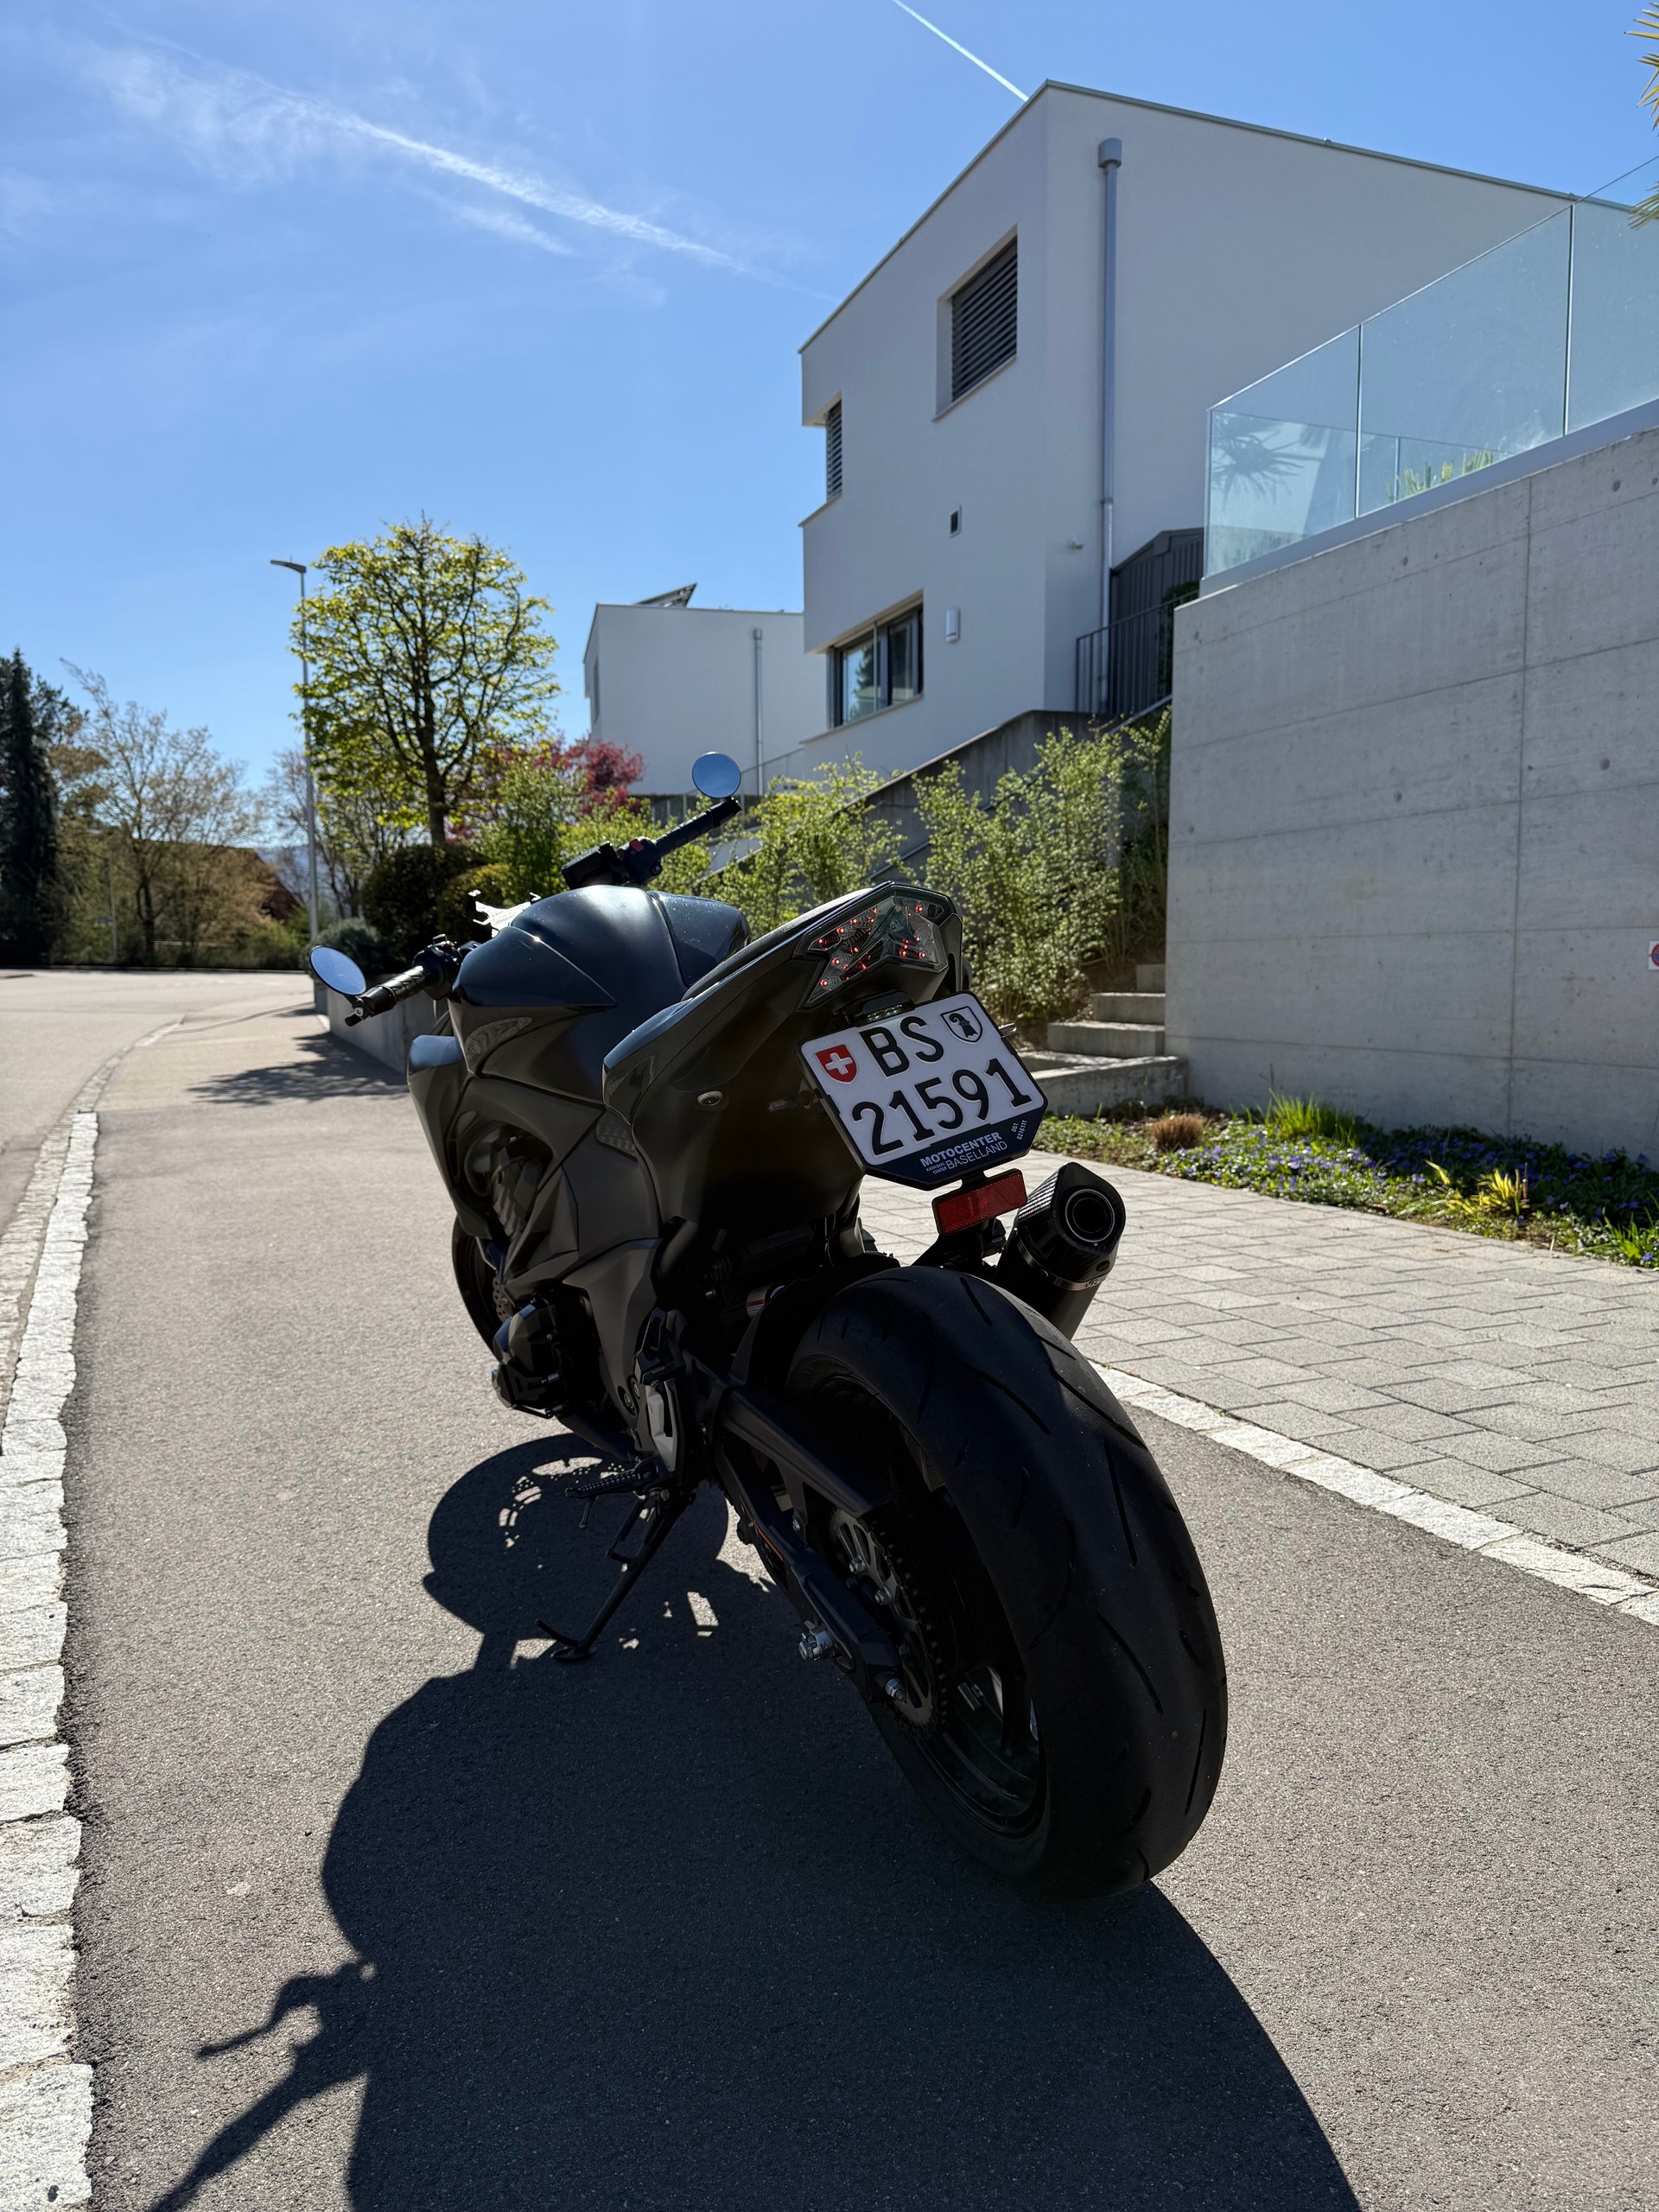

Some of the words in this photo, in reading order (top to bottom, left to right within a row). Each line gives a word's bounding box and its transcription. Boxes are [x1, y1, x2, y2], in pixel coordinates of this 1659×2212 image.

[859, 1016, 944, 1077] BS
[852, 1058, 1033, 1156] 21591
[920, 1132, 1002, 1166] MOTOCENTER
[945, 1141, 1007, 1169] BASELLAND
[932, 1166, 948, 1174] CENTER
